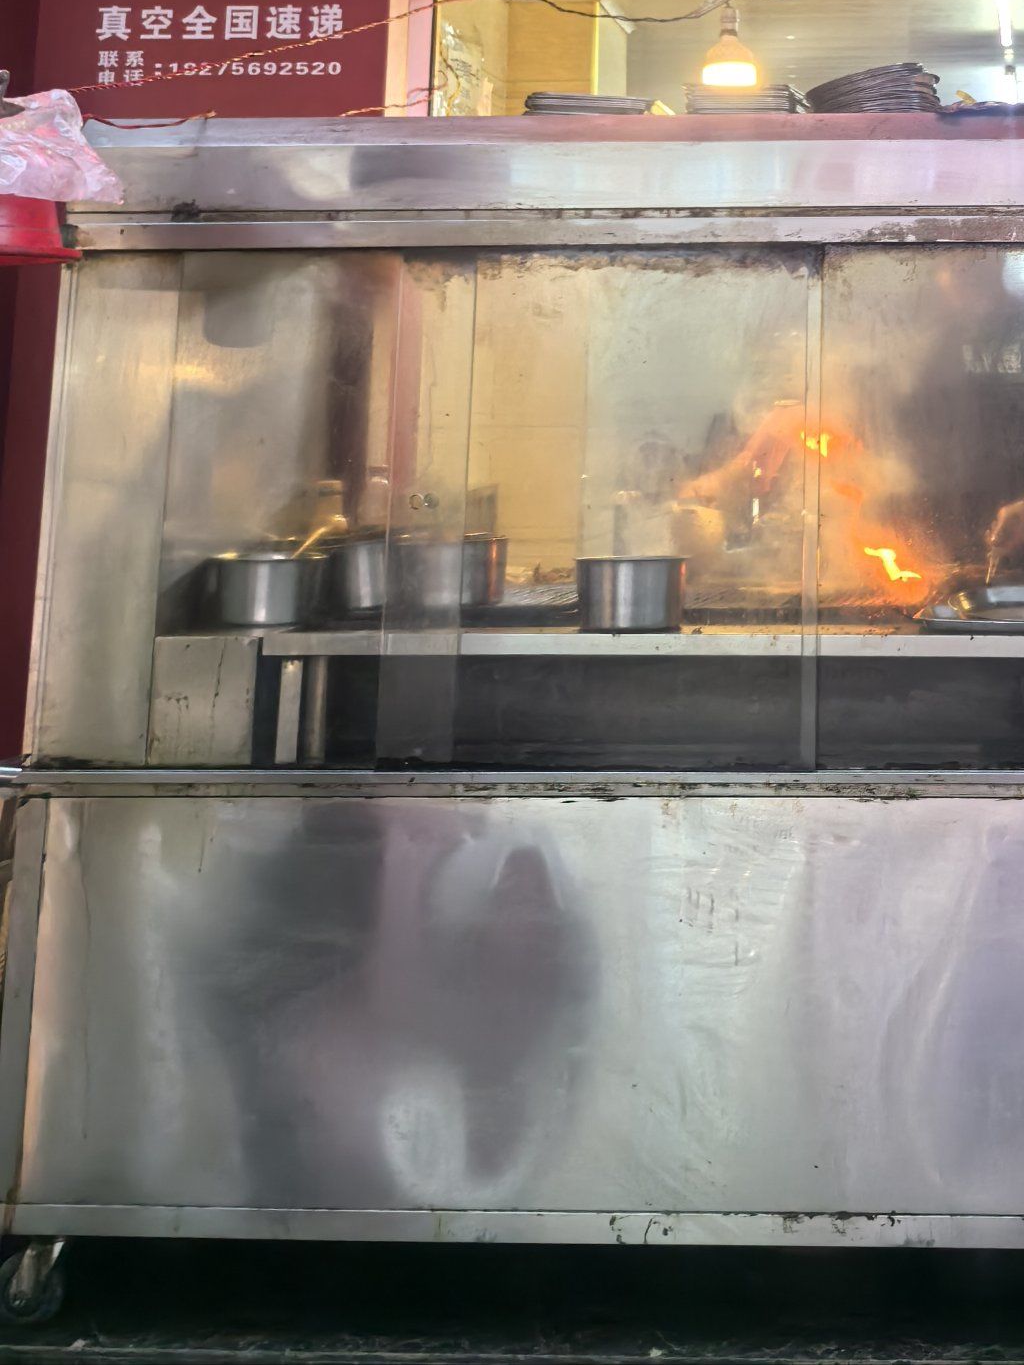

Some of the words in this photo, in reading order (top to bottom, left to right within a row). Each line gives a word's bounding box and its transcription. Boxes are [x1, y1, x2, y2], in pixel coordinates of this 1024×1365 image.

[95, 3, 344, 40] 真空全国速递
[97, 50, 144, 68] 联系
[98, 69, 144, 86] 电话
